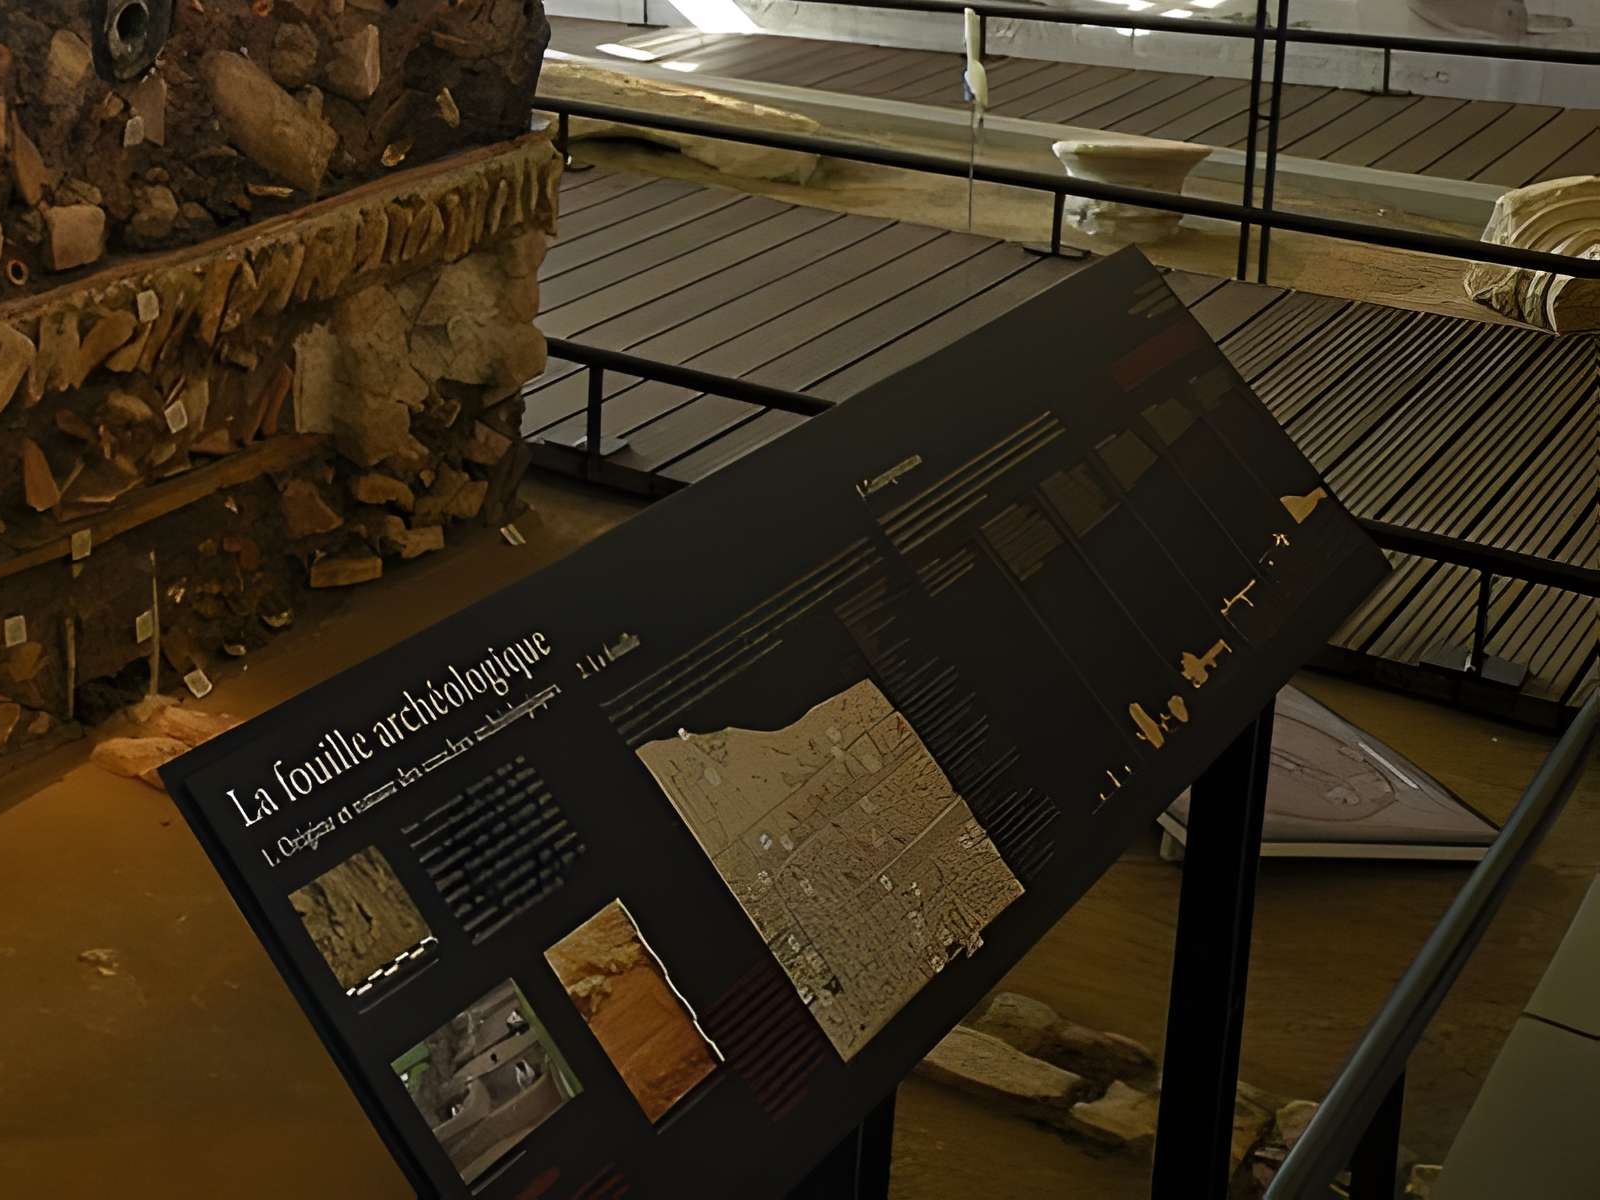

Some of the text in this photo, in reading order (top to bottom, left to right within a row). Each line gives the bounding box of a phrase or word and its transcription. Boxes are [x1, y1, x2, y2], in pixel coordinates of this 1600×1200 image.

[226, 788, 279, 827] La
[273, 729, 373, 801] fouille
[372, 632, 551, 748] archéologique
